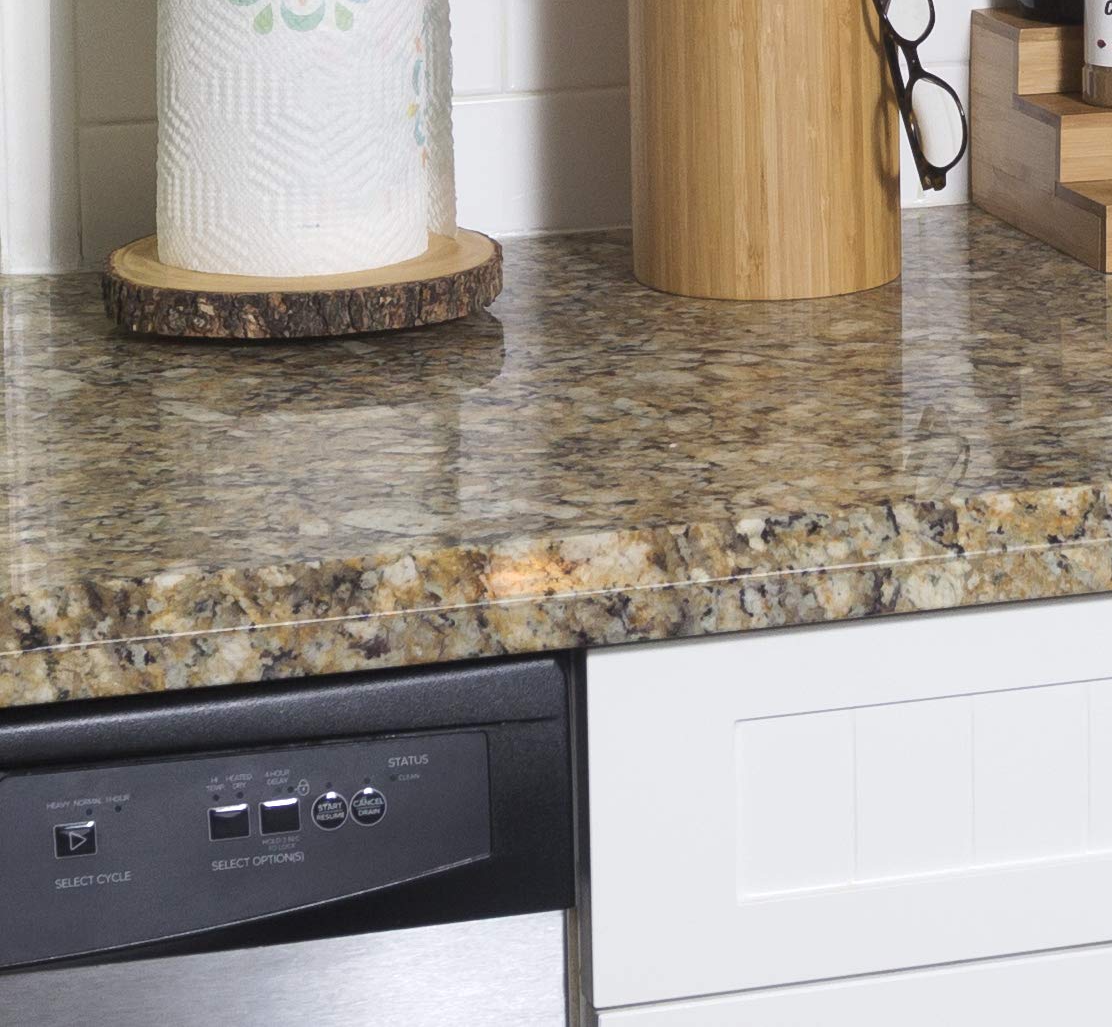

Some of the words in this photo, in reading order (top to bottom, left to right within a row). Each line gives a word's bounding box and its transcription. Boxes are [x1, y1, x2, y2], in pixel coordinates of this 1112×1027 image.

[388, 754, 429, 768] STATUS
[270, 769, 290, 777] HOUR
[226, 774, 253, 782] HEATED
[266, 777, 288, 786] DELAY
[232, 782, 246, 790] DRY
[46, 801, 70, 810] HEAVY
[73, 798, 101, 807] NORMAL
[318, 802, 342, 812] START
[352, 797, 383, 808] CANCEL
[316, 812, 344, 821] RESUME
[358, 808, 381, 817] DRAIN
[211, 856, 250, 871] SELECT
[252, 851, 305, 867] OPTION(S)
[55, 875, 94, 889] SELECT
[96, 871, 131, 885] CYCLE
